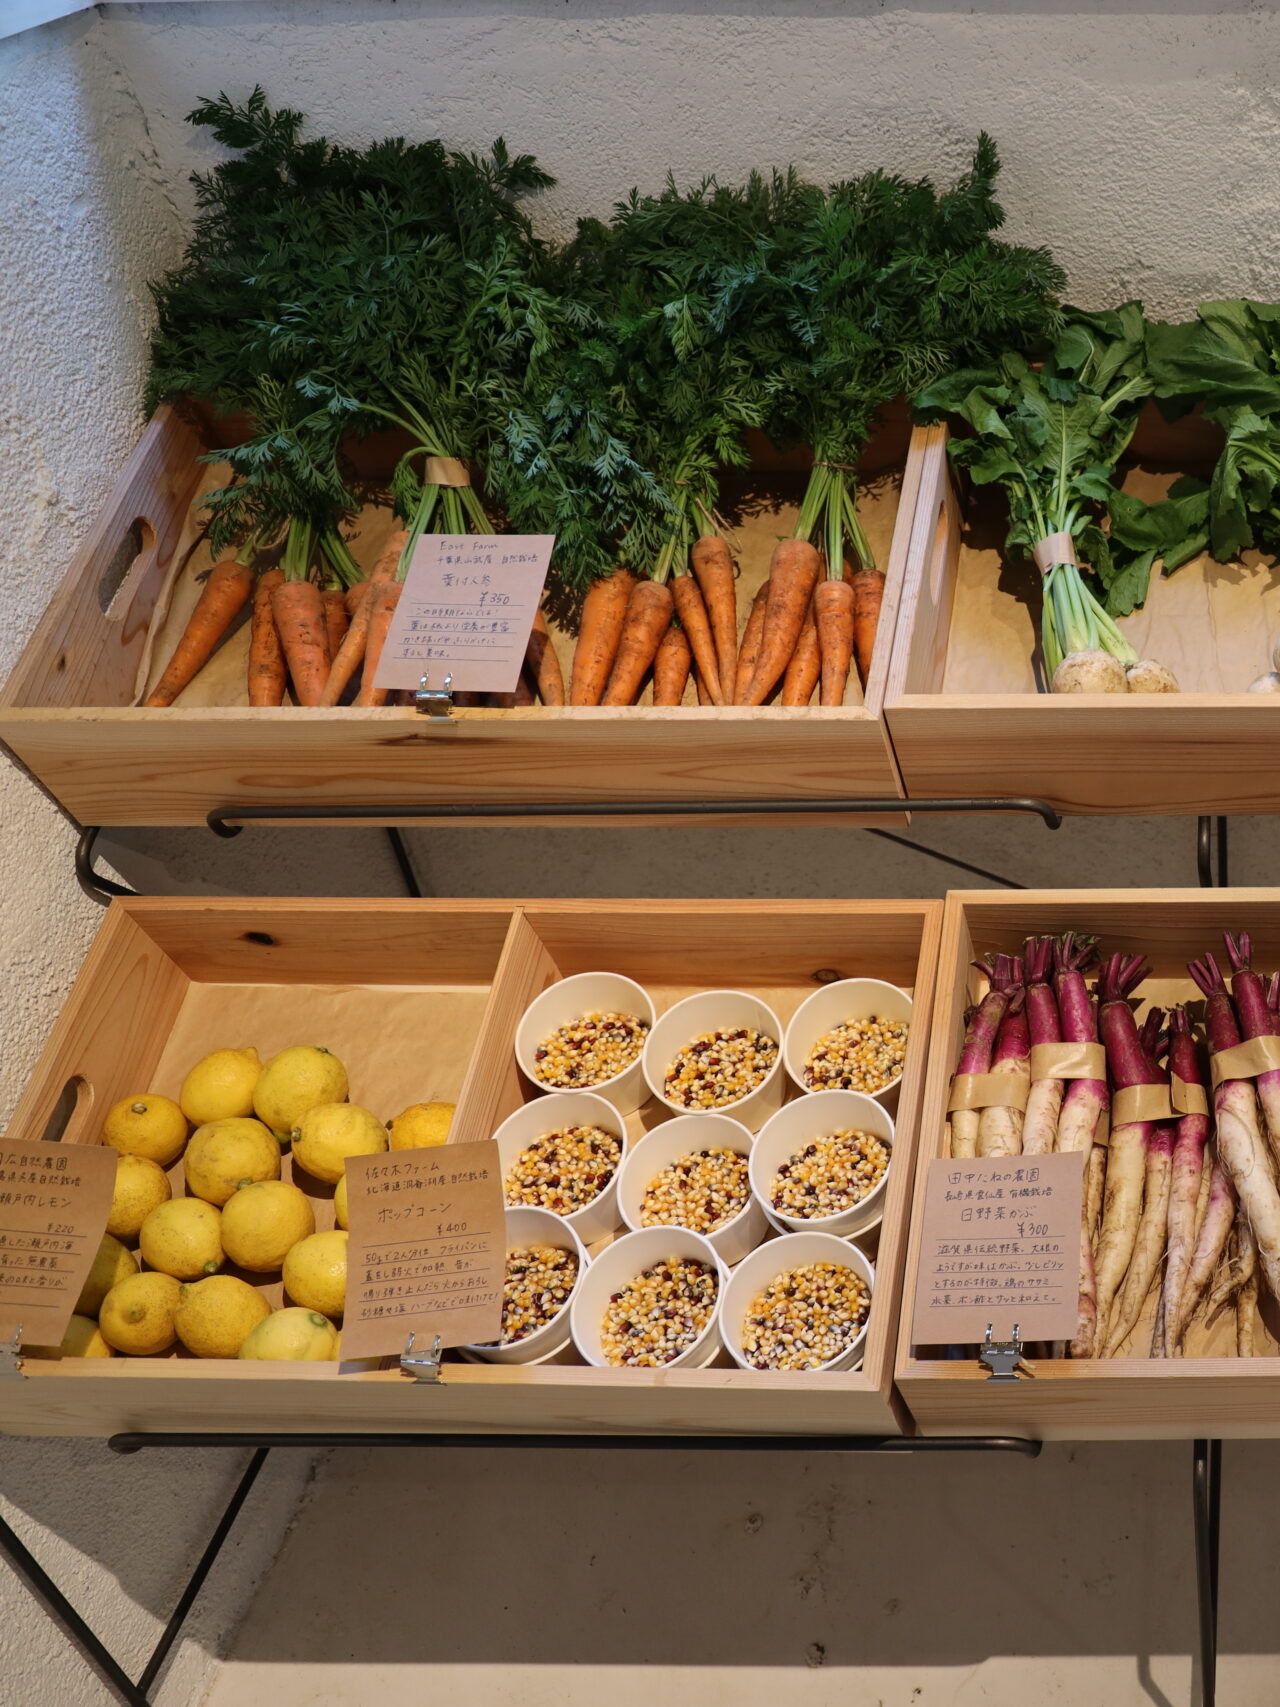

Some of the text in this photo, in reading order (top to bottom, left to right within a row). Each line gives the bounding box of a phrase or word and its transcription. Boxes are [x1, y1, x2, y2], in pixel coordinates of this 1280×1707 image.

[479, 591, 510, 607] ¥350
[365, 1160, 440, 1180] 佐々木ファーム
[947, 1167, 1041, 1186] 田中たねの農園
[377, 1202, 453, 1224] ポップコーン
[436, 1222, 468, 1237] ¥400
[1017, 1221, 1050, 1238] ¥300
